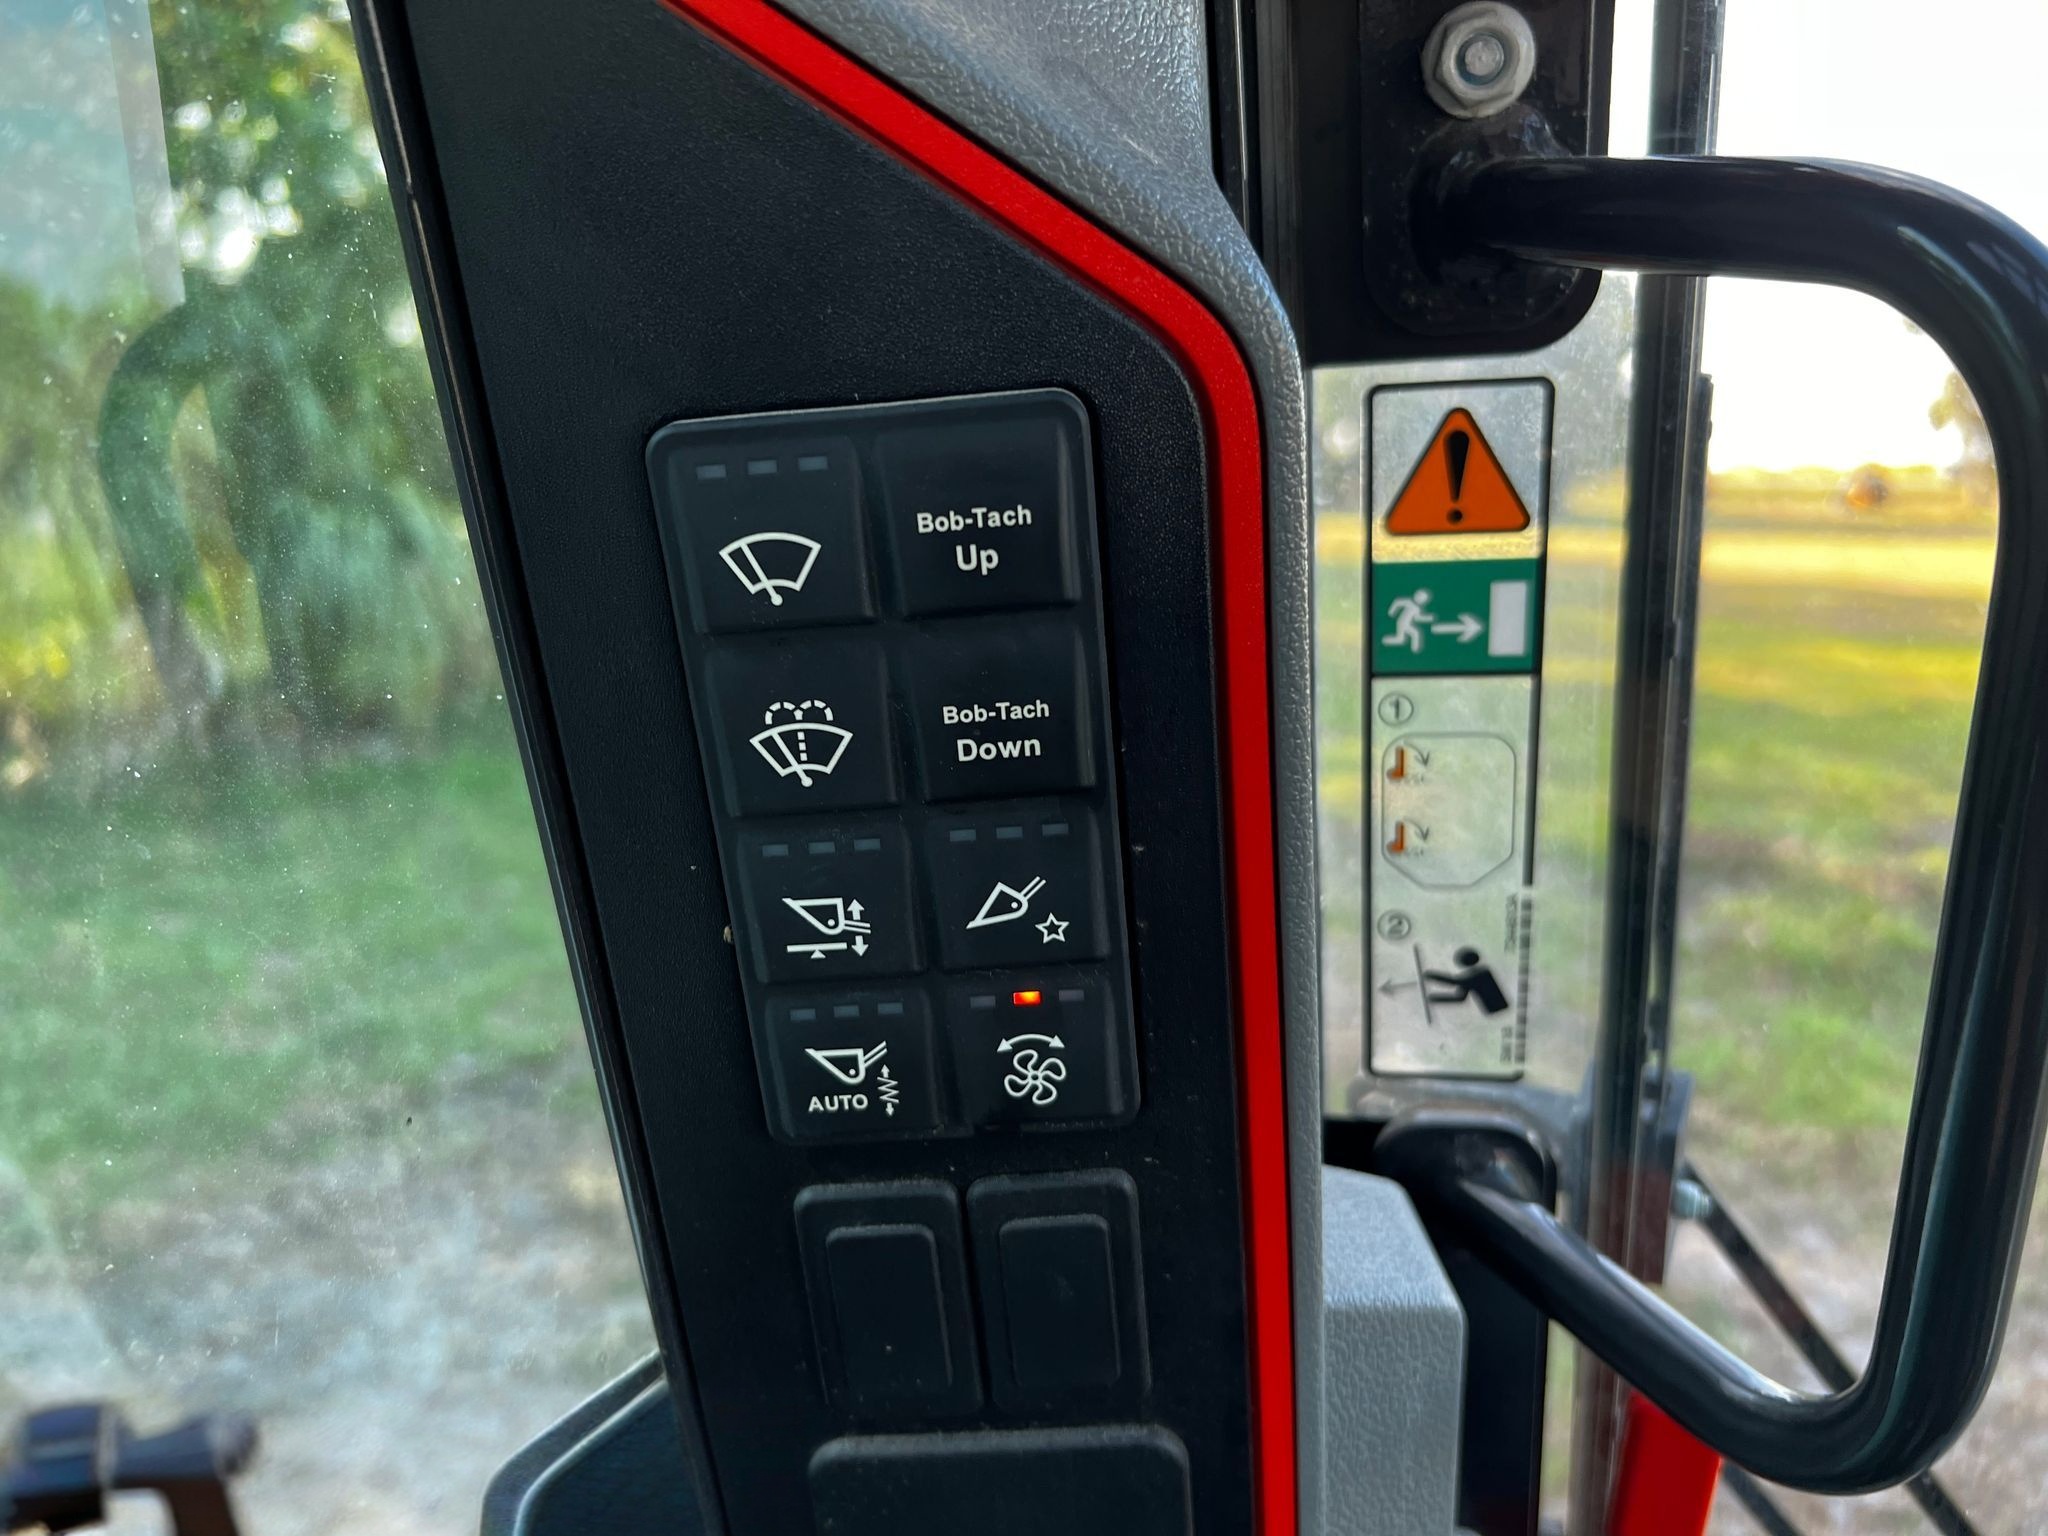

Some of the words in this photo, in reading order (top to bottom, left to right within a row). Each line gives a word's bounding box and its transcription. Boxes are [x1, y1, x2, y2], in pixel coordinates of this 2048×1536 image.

[916, 504, 1033, 534] Bob-Tach
[955, 543, 1000, 576] Up
[942, 699, 1050, 725] Bob-Tach
[956, 737, 1042, 763] Down
[807, 1093, 869, 1113] AUTO
